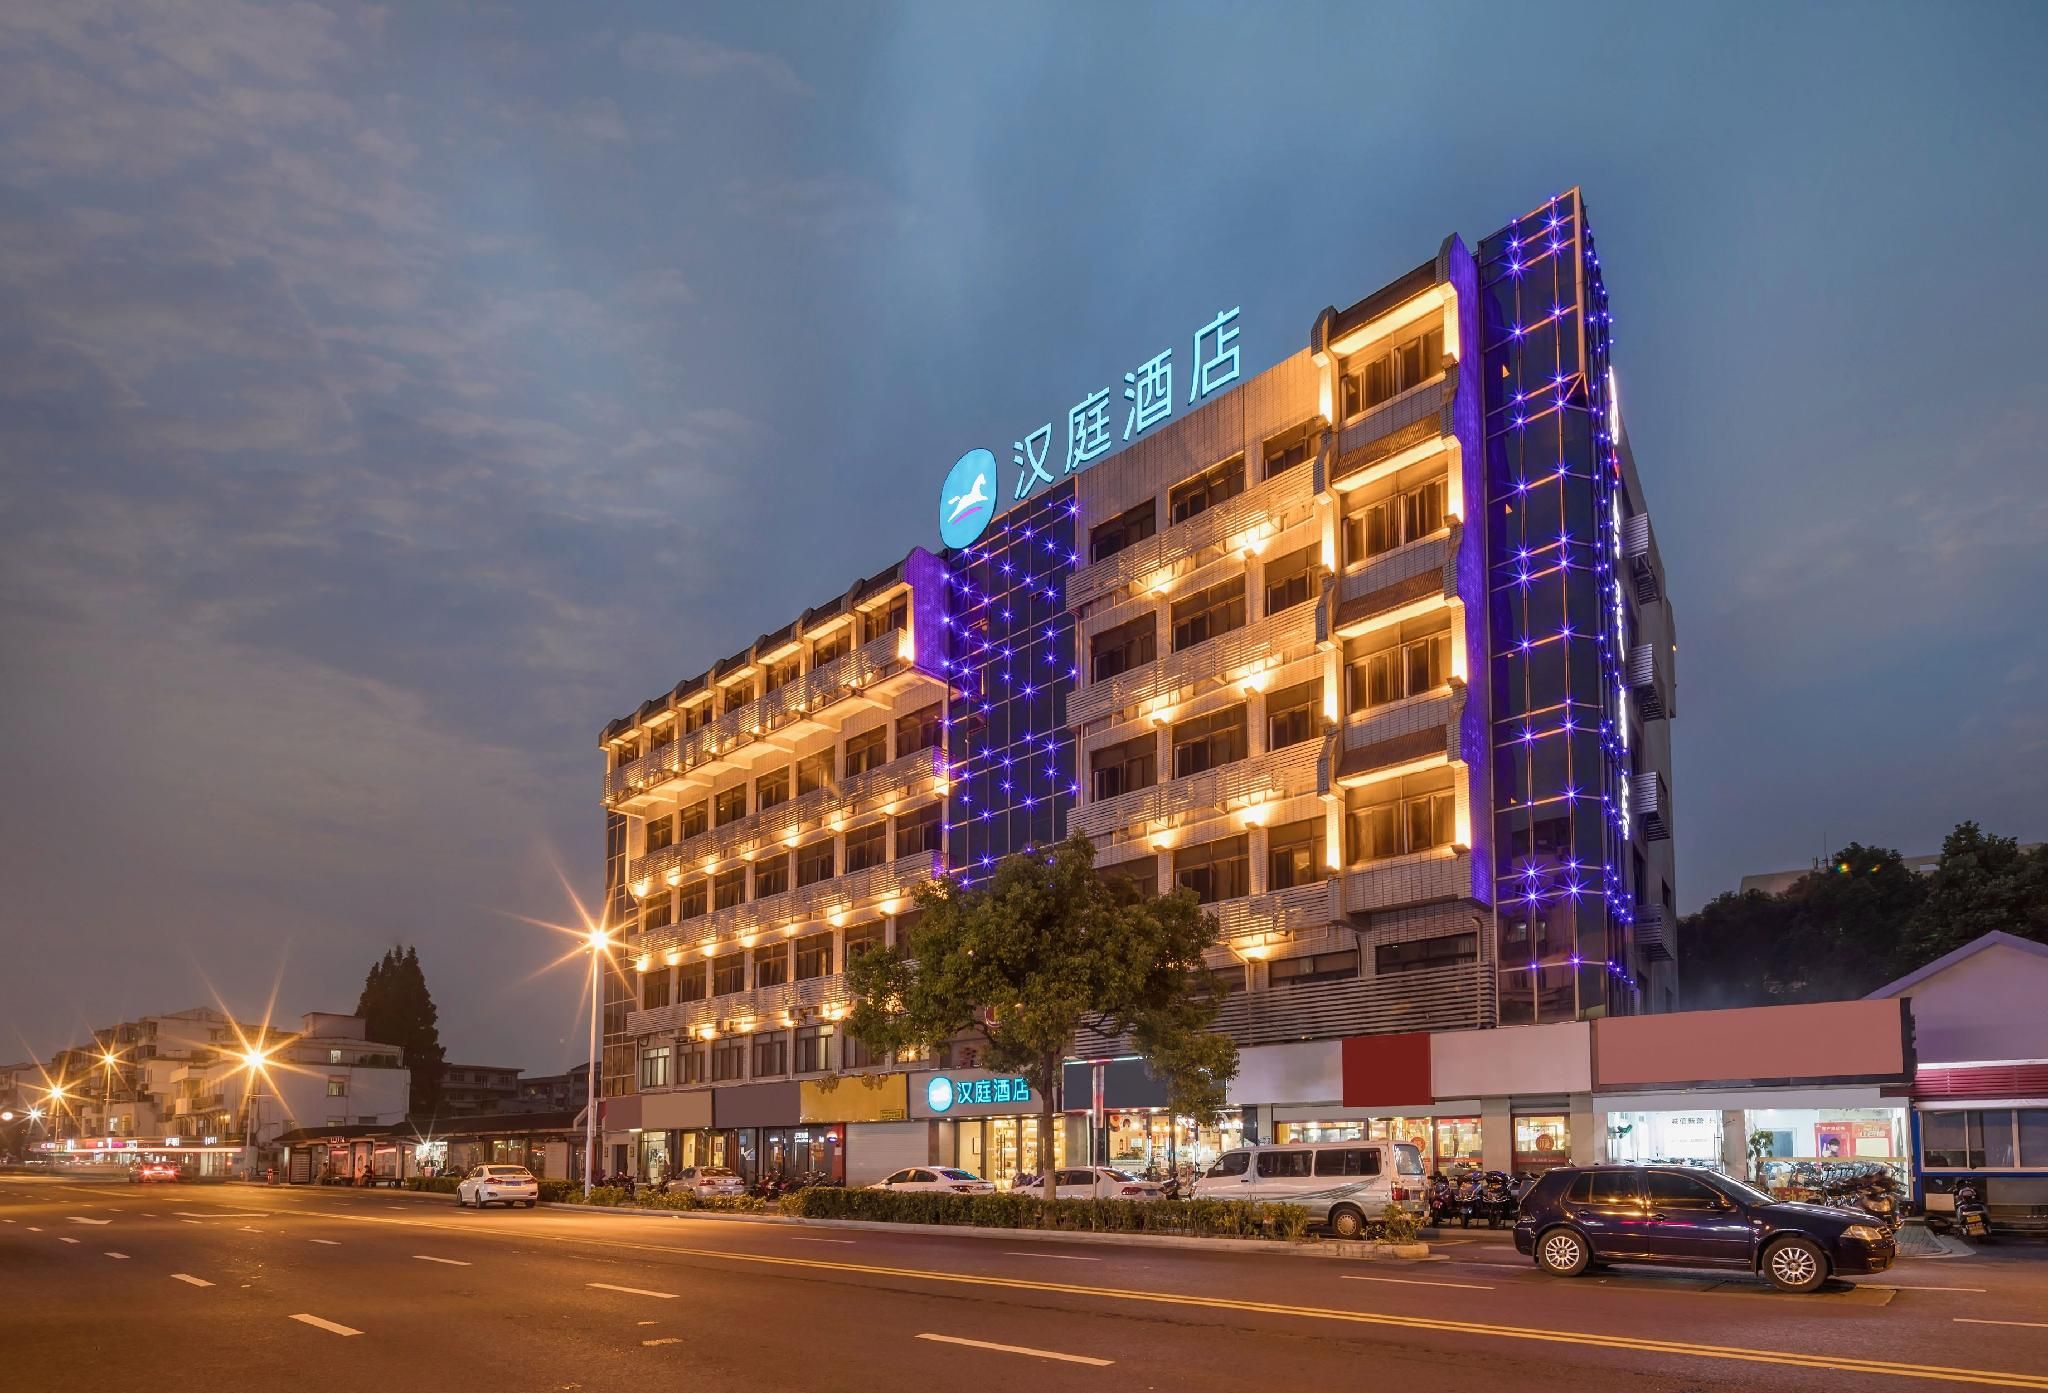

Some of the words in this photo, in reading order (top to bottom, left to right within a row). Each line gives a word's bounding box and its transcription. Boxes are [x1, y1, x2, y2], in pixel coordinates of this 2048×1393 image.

[1013, 305, 1240, 500] 汉庭酒店
[957, 1077, 1029, 1104] 汉庭酒店
